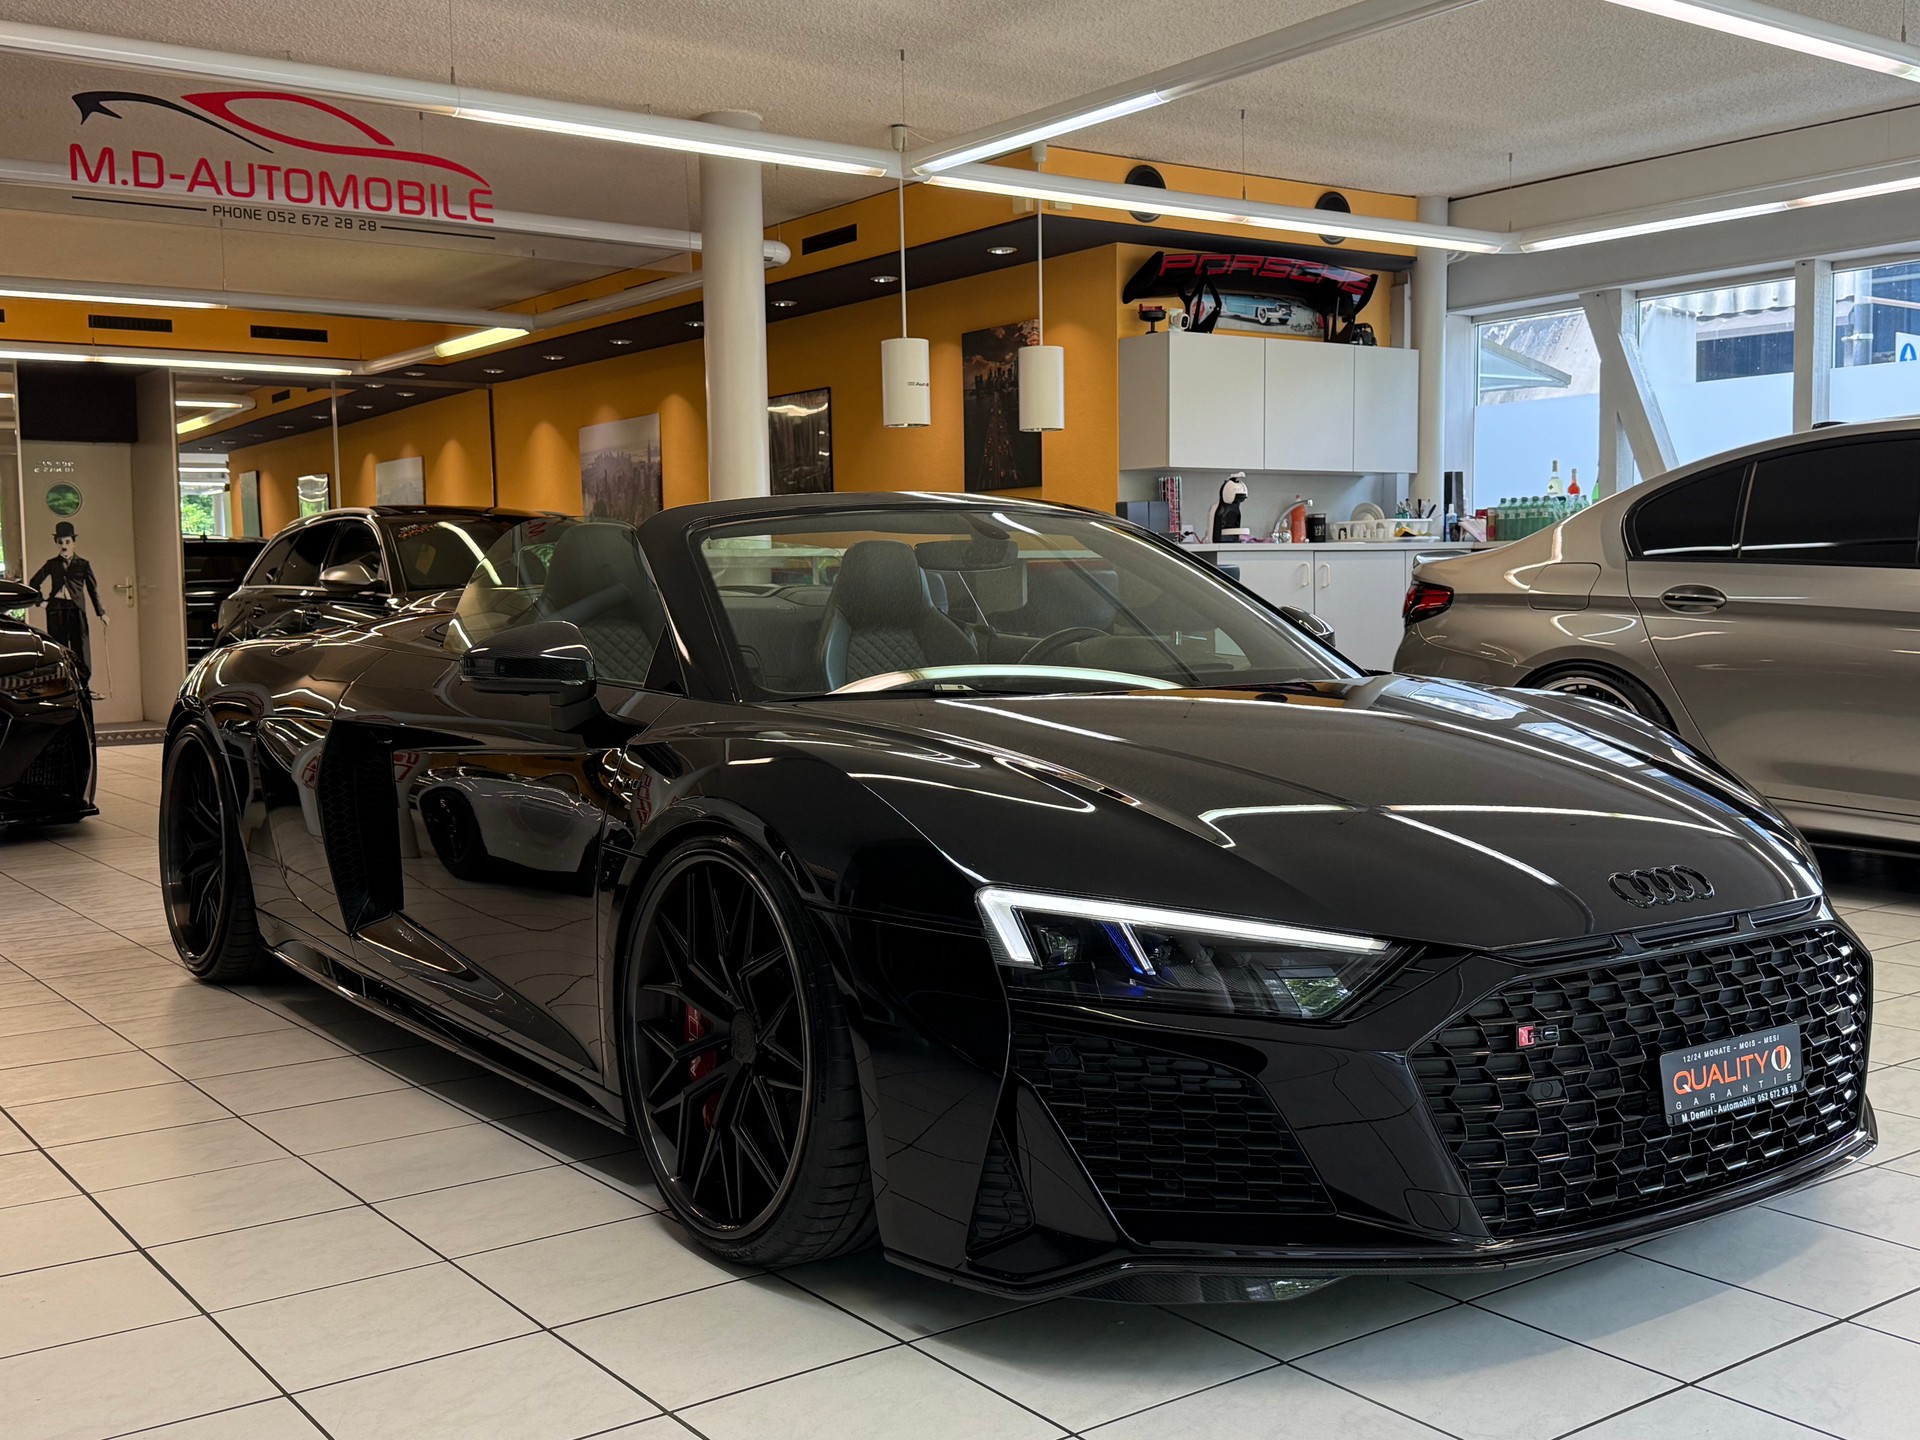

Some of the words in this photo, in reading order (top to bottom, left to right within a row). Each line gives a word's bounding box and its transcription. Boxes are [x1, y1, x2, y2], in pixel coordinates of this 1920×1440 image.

[69, 143, 494, 223] M.D-AUTOMOBILE
[213, 205, 262, 221] PHONE
[267, 210, 296, 224] 052
[302, 214, 329, 227] 672
[334, 216, 353, 229] 28
[358, 219, 377, 231] 28
[1159, 253, 1373, 296] PORSCHE
[1682, 1052, 1702, 1063] 12/24
[1703, 1045, 1731, 1058] MONATE
[1739, 1039, 1756, 1050] MOIS
[1763, 1034, 1780, 1044] MESI
[1673, 1050, 1769, 1095] QUALITY
[1675, 1073, 1792, 1110] GARANTIE
[1757, 1092, 1769, 1102] 052
[1769, 1089, 1780, 1099] 672
[1781, 1086, 1789, 1096] 28
[1790, 1084, 1798, 1093] 28
